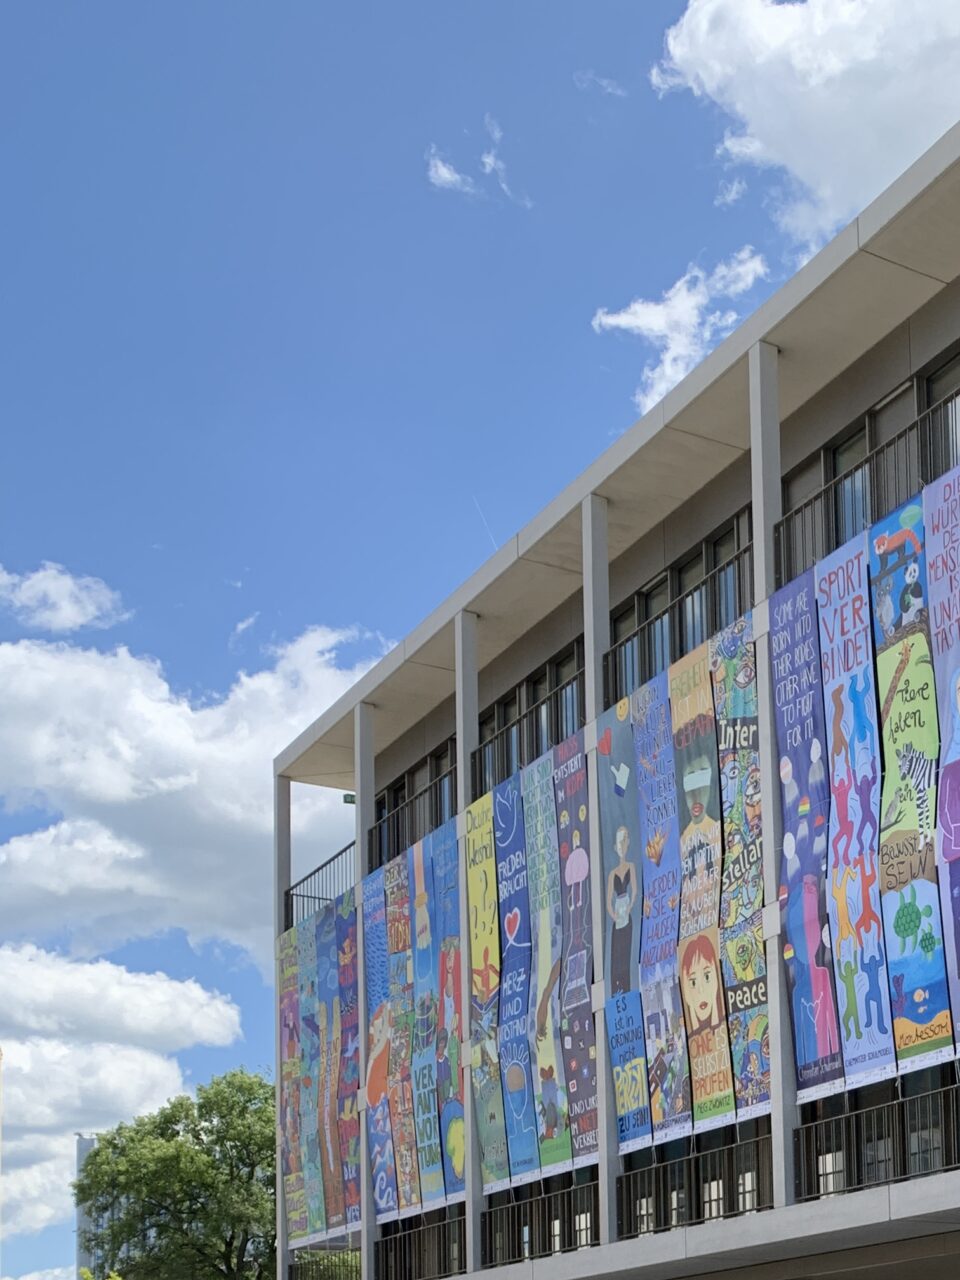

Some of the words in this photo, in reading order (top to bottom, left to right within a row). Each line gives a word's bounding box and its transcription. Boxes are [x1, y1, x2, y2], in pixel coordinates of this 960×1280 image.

[818, 551, 864, 609] SPORT
[774, 598, 793, 630] SOME
[772, 627, 791, 656] BORN
[822, 625, 869, 686] BINDET
[782, 704, 795, 727] TO
[719, 719, 757, 750] Inter
[787, 724, 802, 751] FOR
[722, 838, 763, 890] stellar
[499, 871, 527, 903] BRAUCHT
[682, 866, 719, 893] ANDERER
[652, 895, 666, 919] SIE
[680, 908, 718, 939] SCHENKEN
[502, 967, 527, 997] HERZ
[502, 997, 522, 1020] UND
[616, 995, 627, 1014] ES
[728, 982, 767, 1013] peace
[690, 1031, 713, 1059] OHNE
[715, 1025, 727, 1050] ES
[414, 1062, 433, 1091] VER
[693, 1053, 718, 1078] SELBST
[416, 1087, 437, 1118] ANT
[569, 1101, 585, 1117] UND
[618, 1116, 631, 1134] ZU
